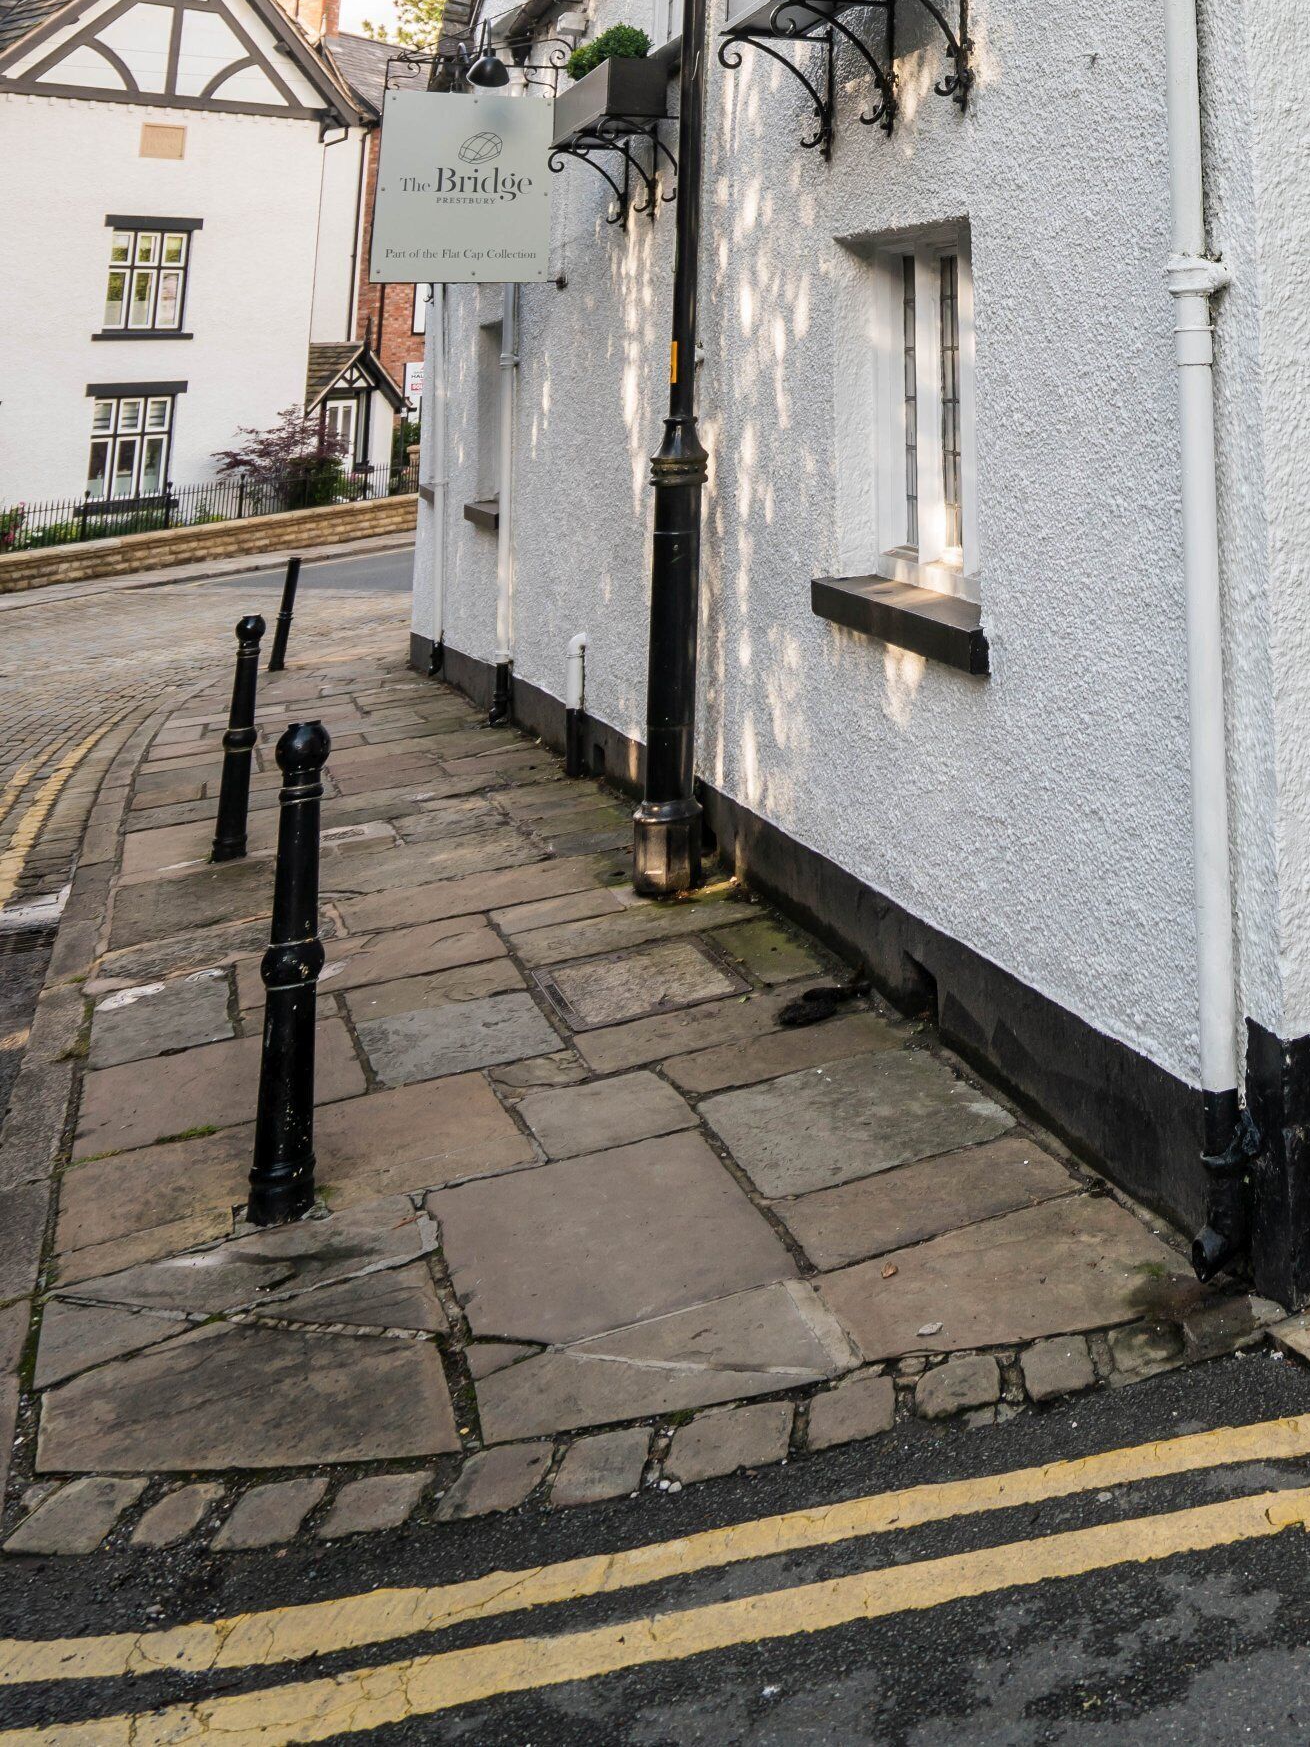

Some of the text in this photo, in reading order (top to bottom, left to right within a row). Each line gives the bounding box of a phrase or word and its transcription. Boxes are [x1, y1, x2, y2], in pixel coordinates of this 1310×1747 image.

[400, 167, 533, 201] The Bridge
[436, 197, 496, 205] PRESTBURY
[385, 249, 537, 260] Part of the Flat Cap Collection
